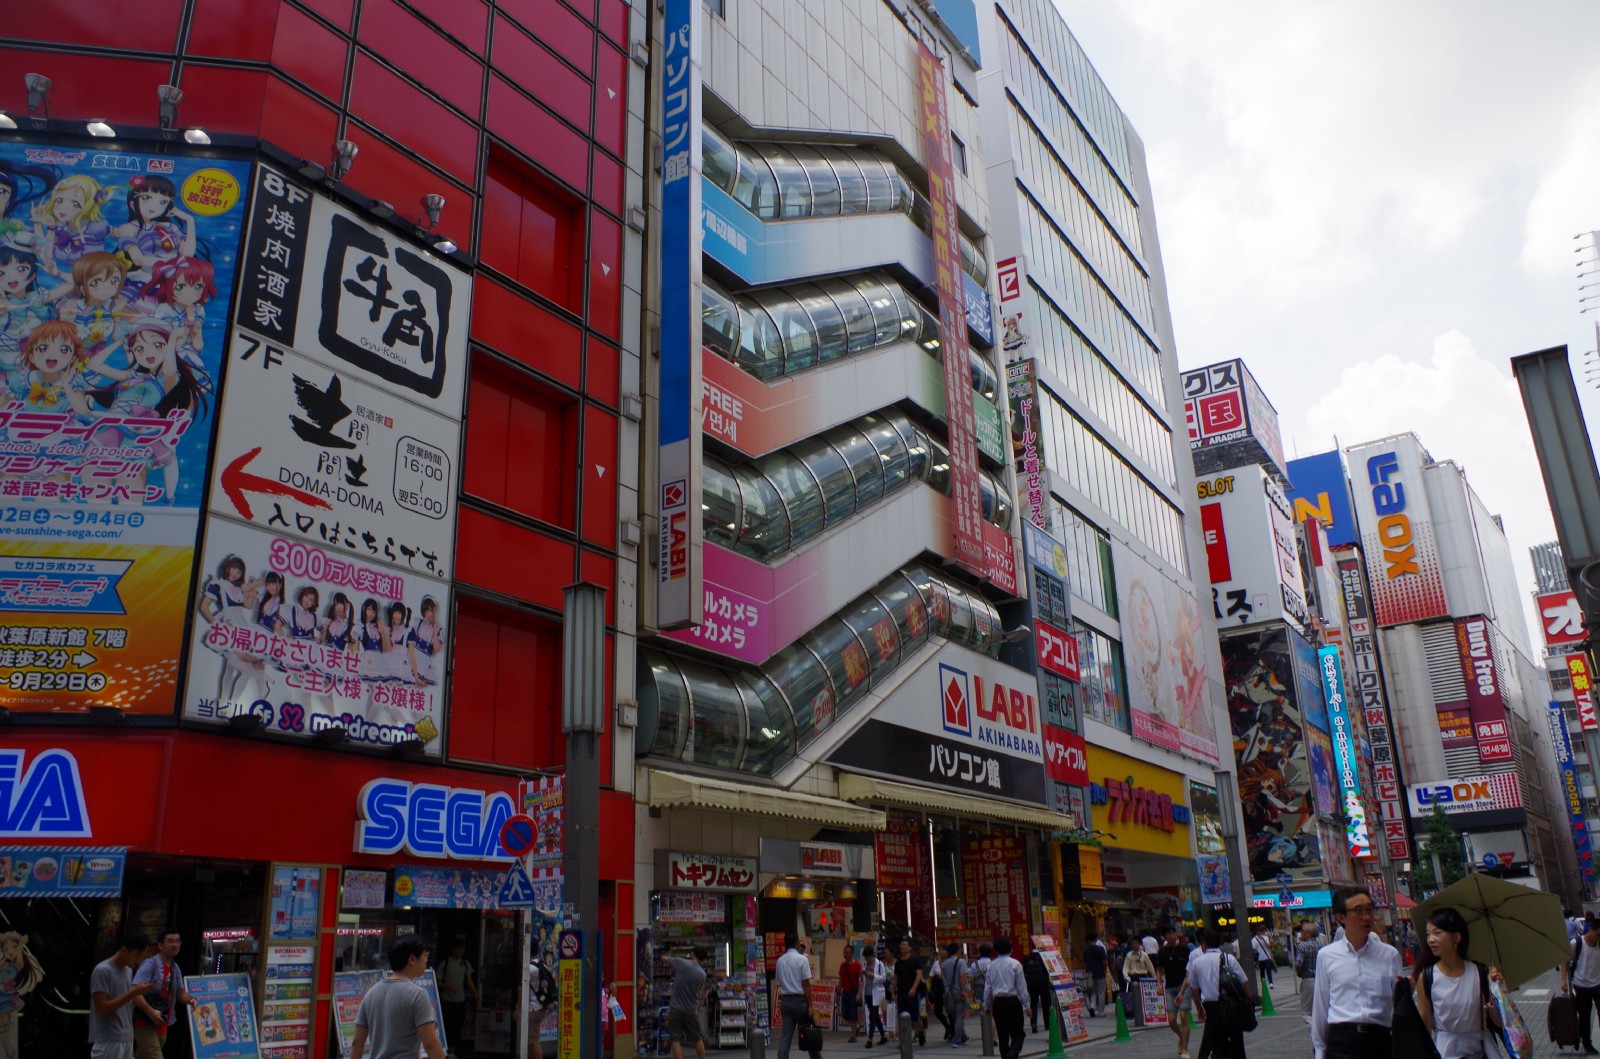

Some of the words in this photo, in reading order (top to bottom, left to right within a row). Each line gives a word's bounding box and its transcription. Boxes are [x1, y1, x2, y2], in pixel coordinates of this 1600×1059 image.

[664, 23, 690, 186] パソコン館
[92, 155, 140, 171] SEGA
[920, 56, 939, 143] TAX
[930, 168, 953, 297] FREE
[195, 174, 233, 190] TVアニメ
[198, 183, 223, 197] 好評
[263, 172, 309, 205] 8F
[252, 203, 296, 332] 焼肉酒家
[238, 332, 284, 370] 7F
[359, 336, 408, 365] Gyu-Kaku
[702, 383, 744, 422] FREE
[49, 443, 84, 455] idol
[88, 446, 152, 459] project
[403, 455, 443, 482] 16:00
[406, 442, 442, 466] 営業時間
[278, 466, 385, 517] DOMA-DOMA
[398, 488, 443, 514] 翌5:00
[1197, 475, 1235, 498] SLOT
[268, 502, 446, 578] 入口はこちらです。
[670, 511, 686, 581] LABI
[14, 560, 96, 572] セガコラボカフェ
[94, 629, 128, 648] 7階
[208, 623, 363, 675] お帰りなさいませ
[1039, 628, 1078, 673] アコム
[1457, 623, 1470, 657] Flagship
[1464, 657, 1475, 681] Store
[1466, 620, 1488, 659] Duty
[1473, 658, 1495, 698] Free
[973, 674, 1037, 735] LABI
[978, 725, 1042, 758] AKIHABARA
[1478, 722, 1505, 737] 免税
[1551, 706, 1569, 763] Panasonic
[928, 743, 1002, 789] パソコン館
[1055, 742, 1087, 772] アイフル
[1475, 800, 1495, 809] Store
[1563, 768, 1582, 816] ONODEN
[358, 777, 521, 864] SEGA
[814, 847, 842, 864] LABI
[672, 860, 754, 888] トキワムセン
